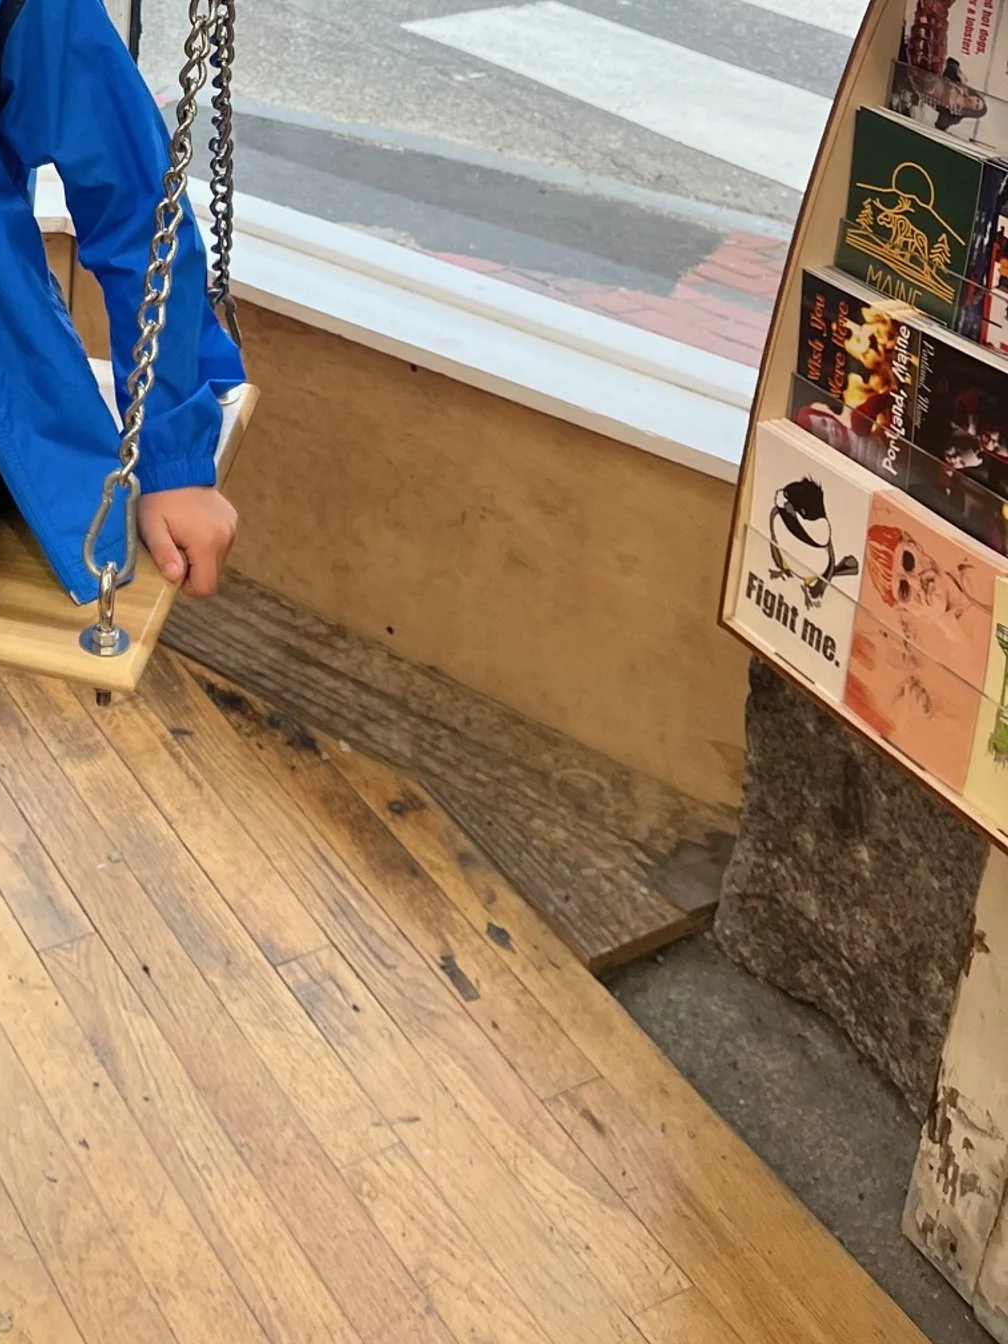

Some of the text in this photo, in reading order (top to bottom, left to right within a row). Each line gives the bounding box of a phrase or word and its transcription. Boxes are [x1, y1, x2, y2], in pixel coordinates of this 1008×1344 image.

[960, 16, 976, 56] lobster!
[975, 28, 990, 56] dogs,
[806, 293, 827, 382] Wish You
[827, 300, 849, 399] Were Here
[881, 324, 912, 476] Portland, Maine
[745, 571, 840, 668] Fight me.
